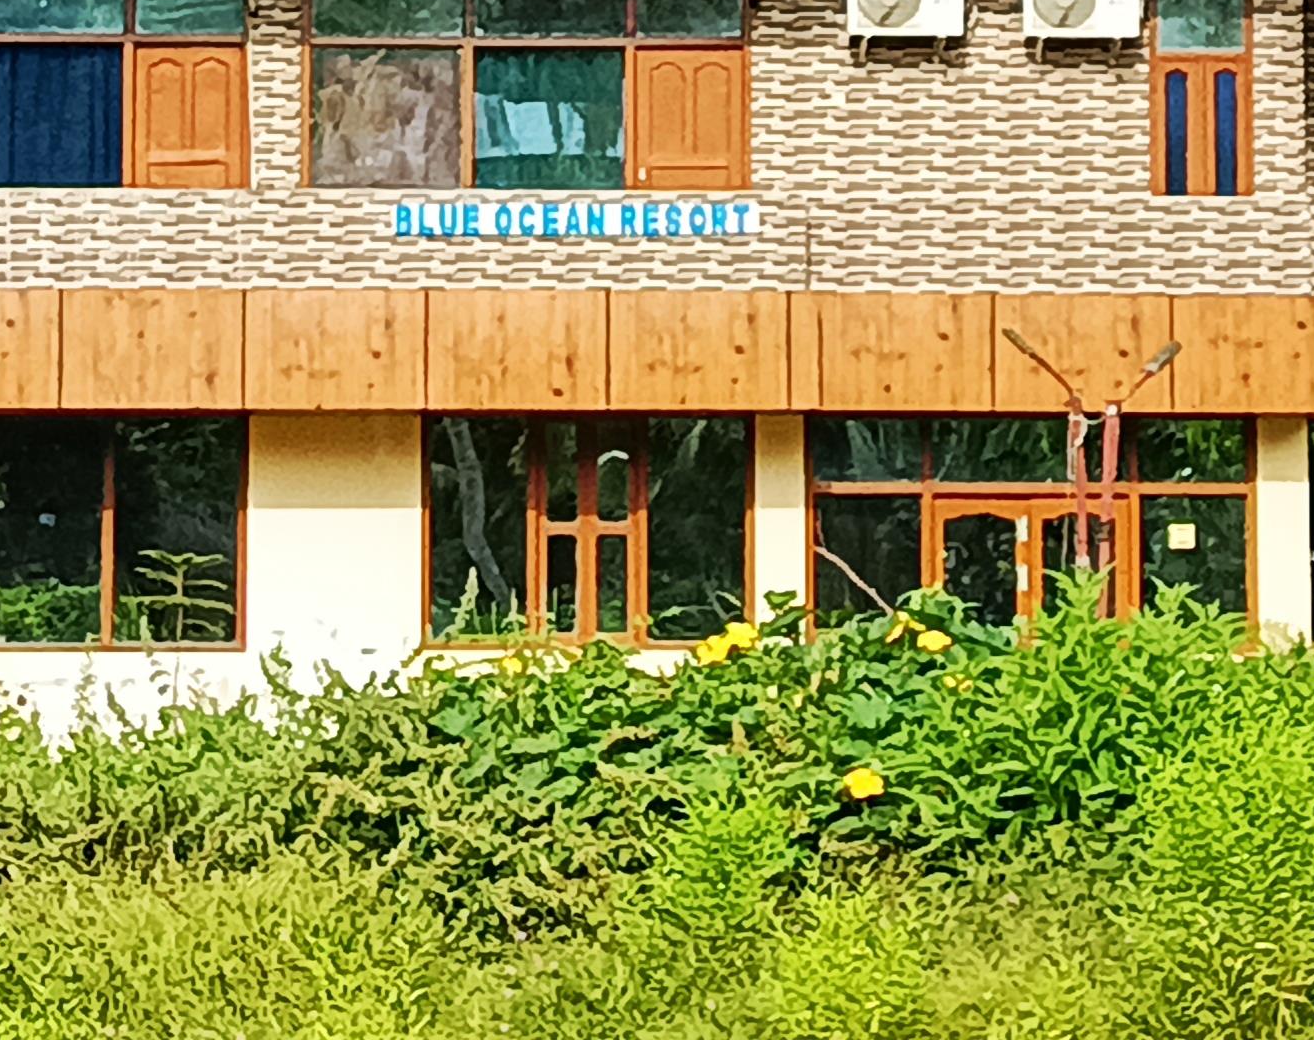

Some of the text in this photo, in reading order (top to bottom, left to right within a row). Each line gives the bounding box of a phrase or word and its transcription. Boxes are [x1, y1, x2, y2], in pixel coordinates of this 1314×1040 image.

[396, 203, 751, 237] BLUE OCEAN RESORT
